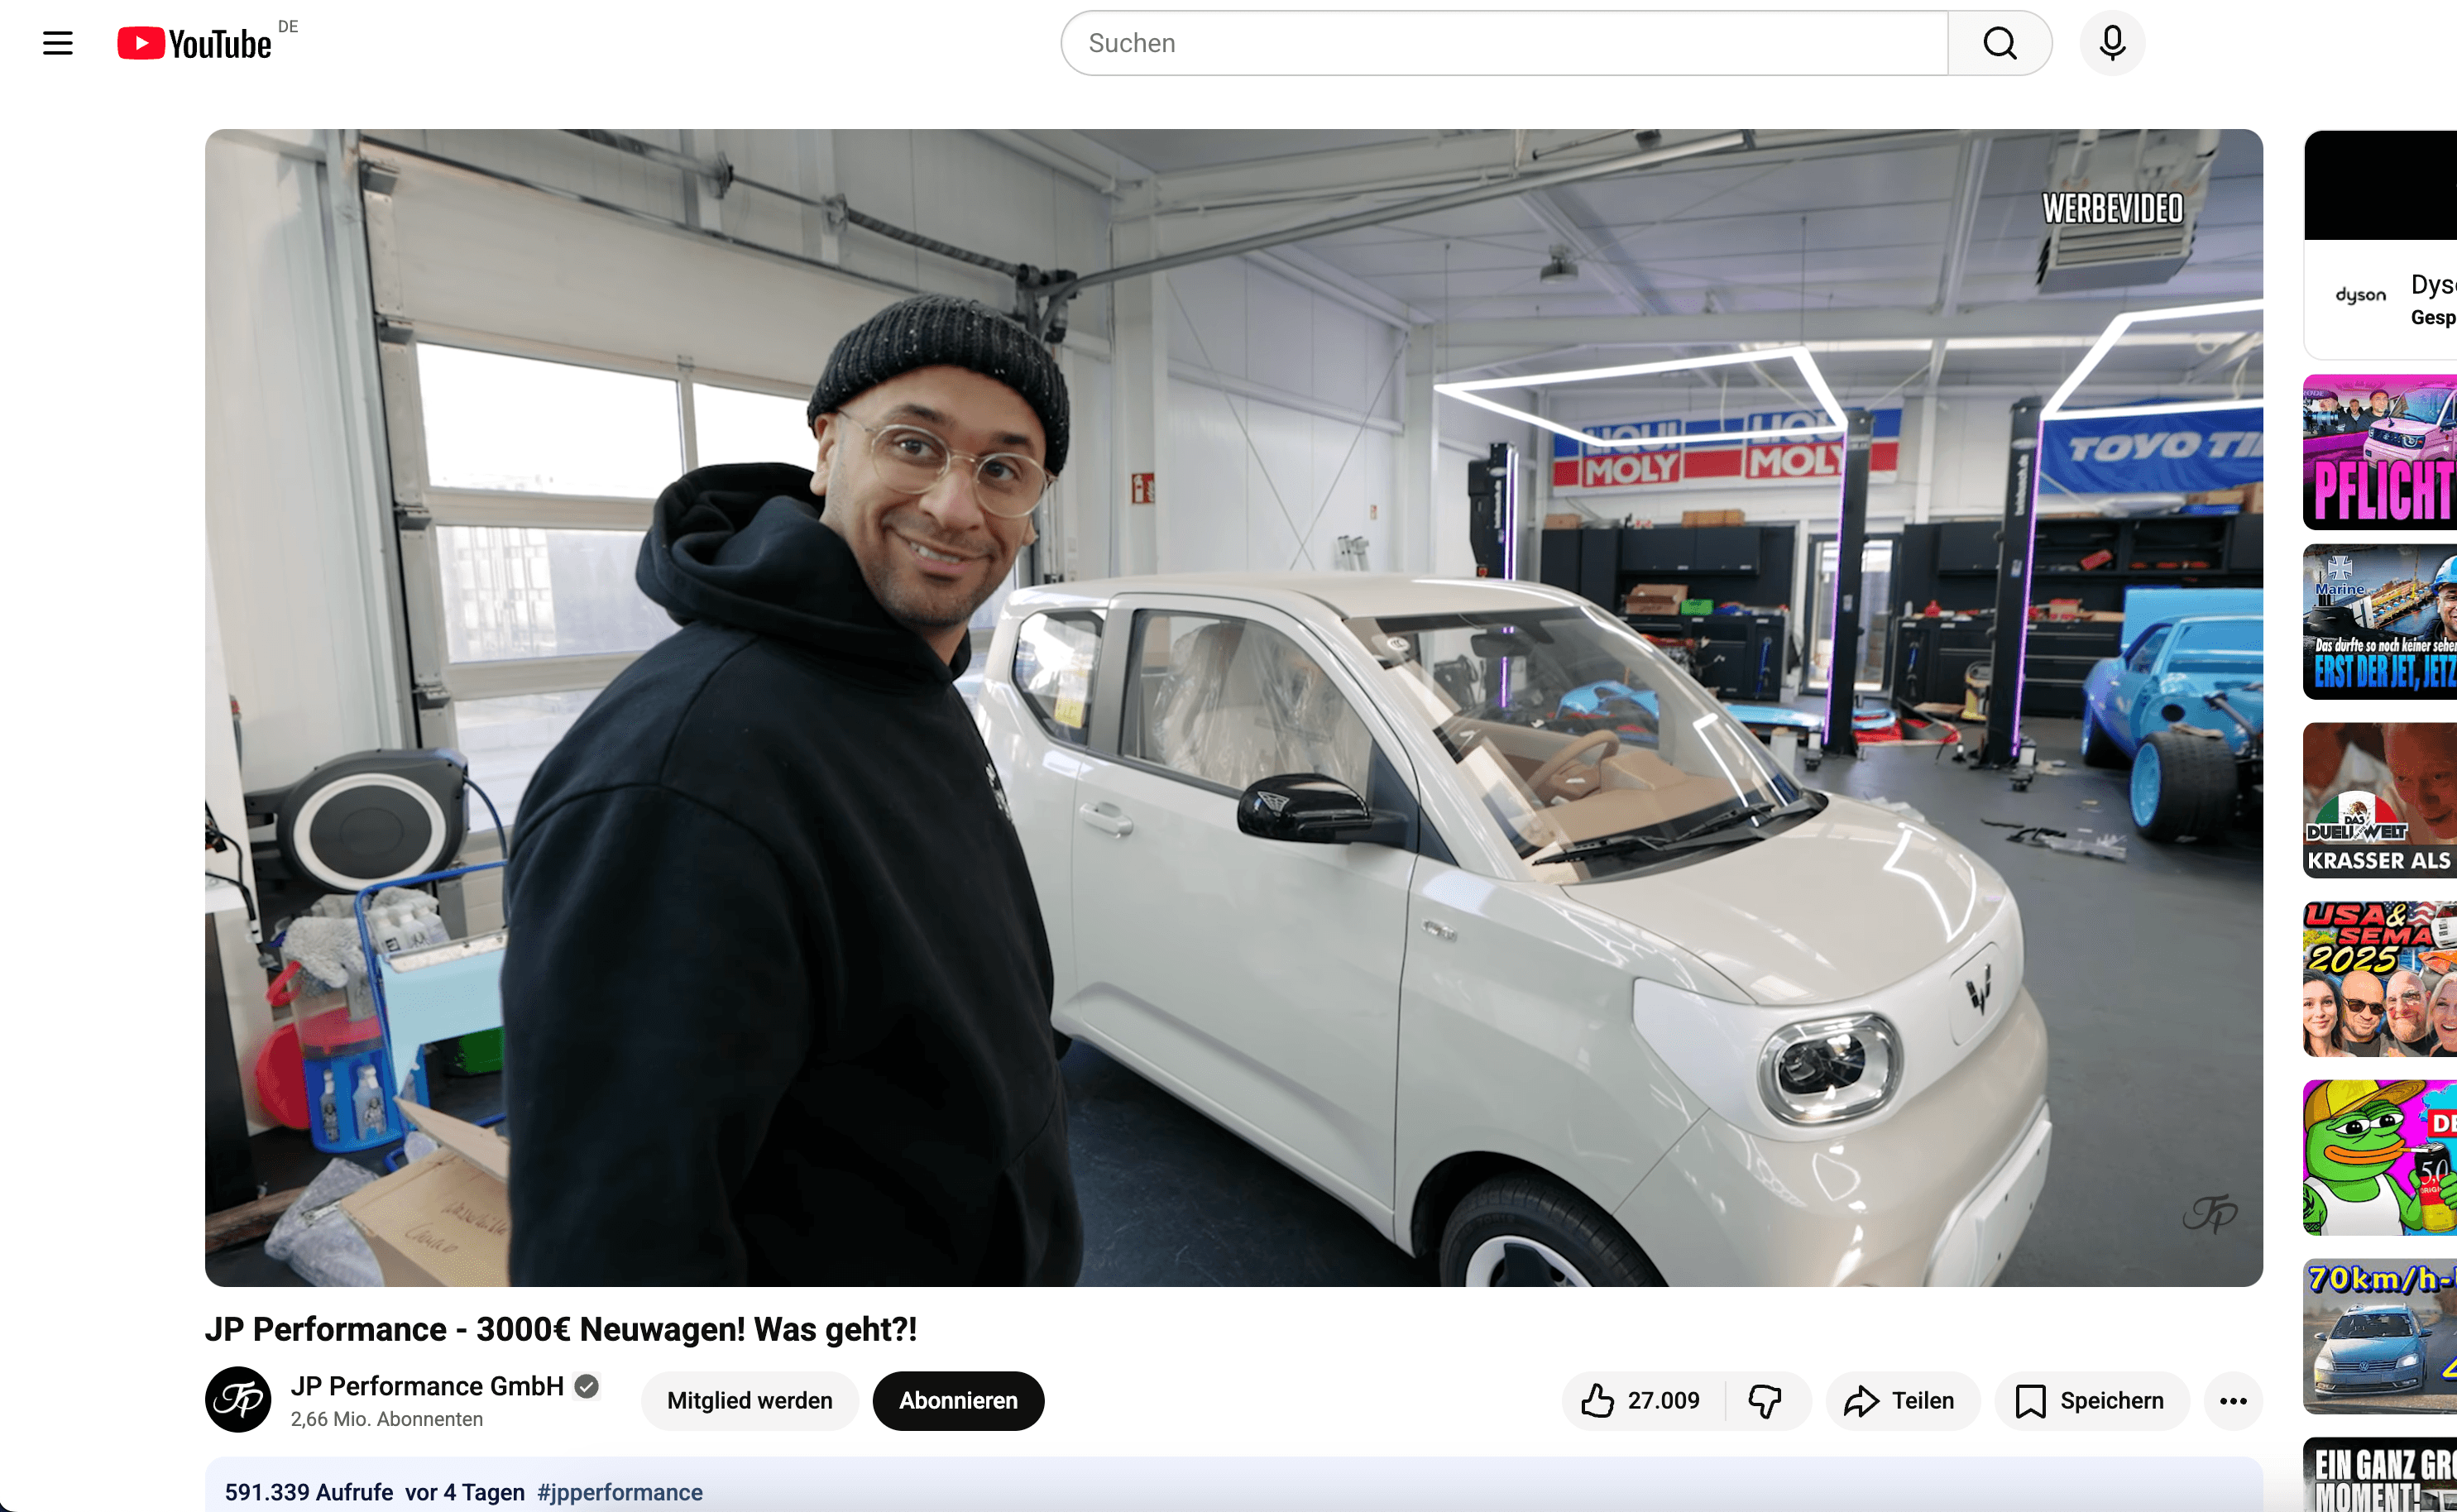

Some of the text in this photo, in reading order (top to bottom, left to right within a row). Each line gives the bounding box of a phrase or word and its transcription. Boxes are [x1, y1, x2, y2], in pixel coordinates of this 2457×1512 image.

[279, 20, 298, 32] DE
[169, 29, 271, 59] YouTube
[1090, 32, 1175, 52] Suchen
[2336, 286, 2386, 306] dyson
[2413, 274, 2457, 299] Dys
[2412, 309, 2456, 328] Gesp
[1751, 411, 1846, 443] LIQU
[2070, 431, 2202, 462] TOYO
[1586, 453, 1679, 486] MOLY
[2316, 461, 2457, 520] PFLICHT
[2316, 583, 2365, 596] Marine
[2316, 636, 2457, 652] Das durfte so noch keiner sehe
[2316, 654, 2354, 687] ERST
[2358, 654, 2388, 687] DER
[2391, 654, 2420, 691] JET,
[2364, 825, 2407, 839] WELT
[2308, 852, 2451, 869] KRASSER ALS
[2306, 903, 2407, 927] USA &
[2338, 927, 2433, 945] SEMA
[2309, 945, 2401, 973] 2025
[2309, 1266, 2457, 1293] 70km/h-
[205, 1317, 244, 1342] JP
[255, 1315, 447, 1342] Performance
[477, 1316, 571, 1342] 3000€
[582, 1317, 745, 1348] Neuwagen!
[754, 1317, 817, 1342] Was
[826, 1315, 916, 1348] geht?!
[291, 1375, 563, 1396] JP Performance GmbH
[668, 1390, 832, 1414] Mitglied werden
[899, 1390, 1018, 1409] Abonnieren
[1629, 1391, 1699, 1409] 27.009
[1892, 1390, 1954, 1409] Teilen
[2062, 1390, 2163, 1414] Speichern
[291, 1410, 482, 1429] 2,66 Mio. Abonnenten
[2316, 1449, 2352, 1480] EIN
[2357, 1449, 2416, 1480] GANZ
[225, 1482, 703, 1505] 591.339 Aufrufe vor 4 Tagen #jpperformance
[2316, 1483, 2420, 1512] MOMENT!
